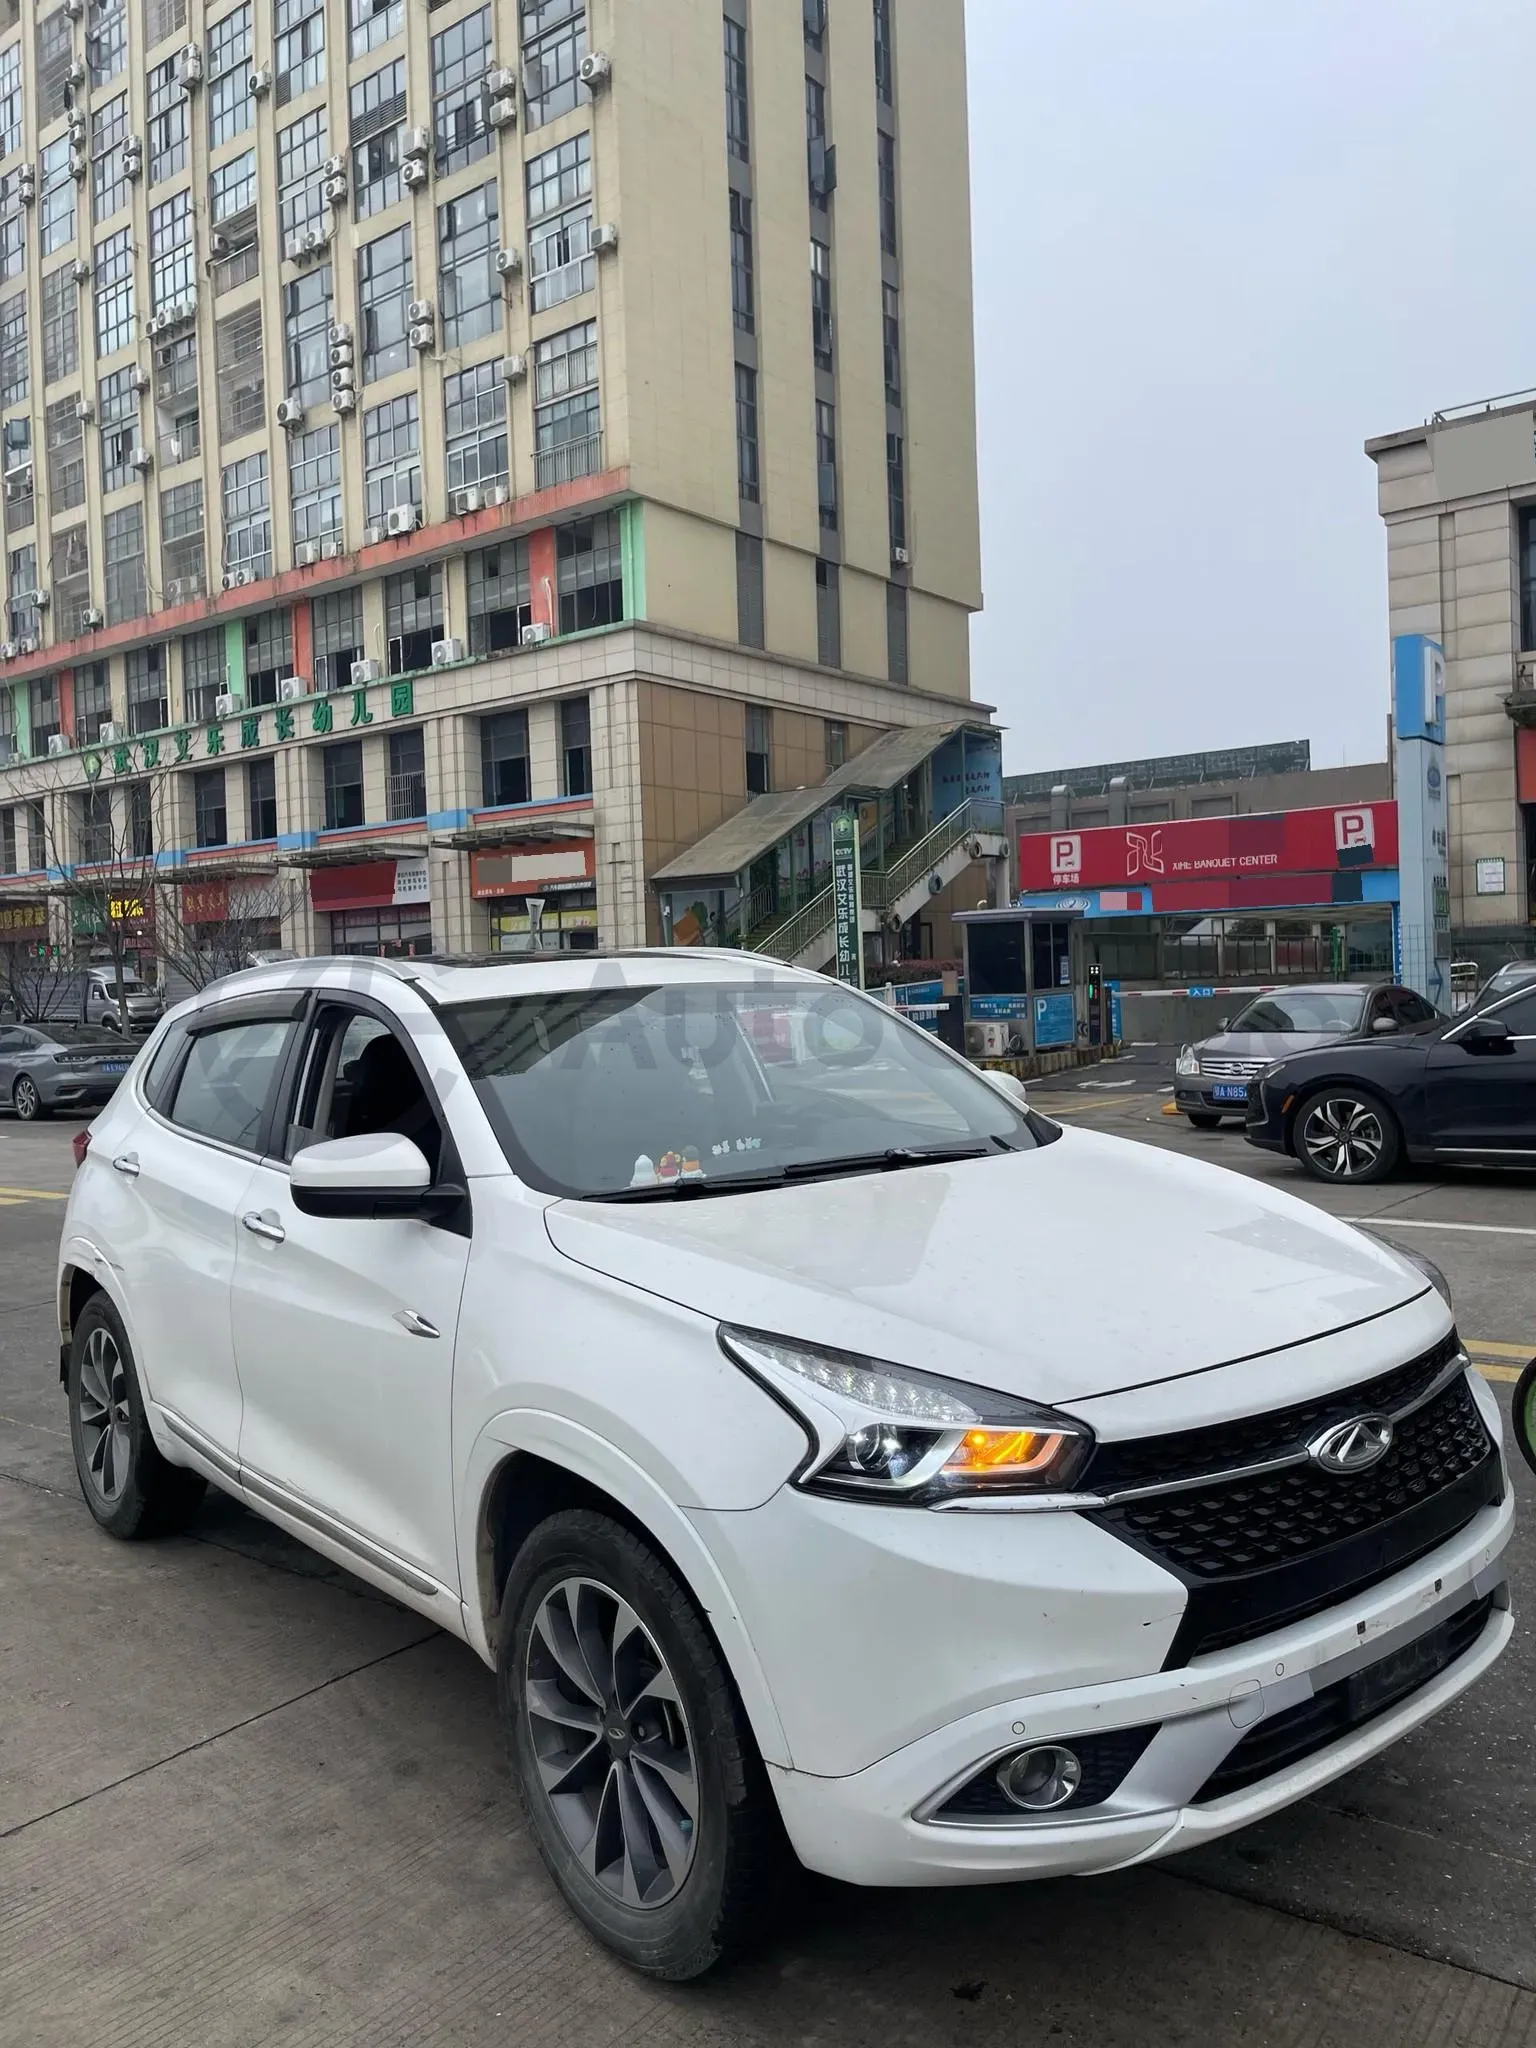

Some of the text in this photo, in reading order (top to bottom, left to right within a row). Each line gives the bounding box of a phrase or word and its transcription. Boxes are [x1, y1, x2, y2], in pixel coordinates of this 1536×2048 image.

[113, 679, 414, 774] 武汉艾乐成长幼儿园
[1342, 815, 1364, 845] P
[1056, 841, 1073, 867] P
[1194, 858, 1237, 869] BANQUET
[1240, 854, 1278, 866] CENTER
[1053, 873, 1080, 885] 停车场
[1193, 988, 1211, 996] 入口
[1037, 999, 1047, 1020] P
